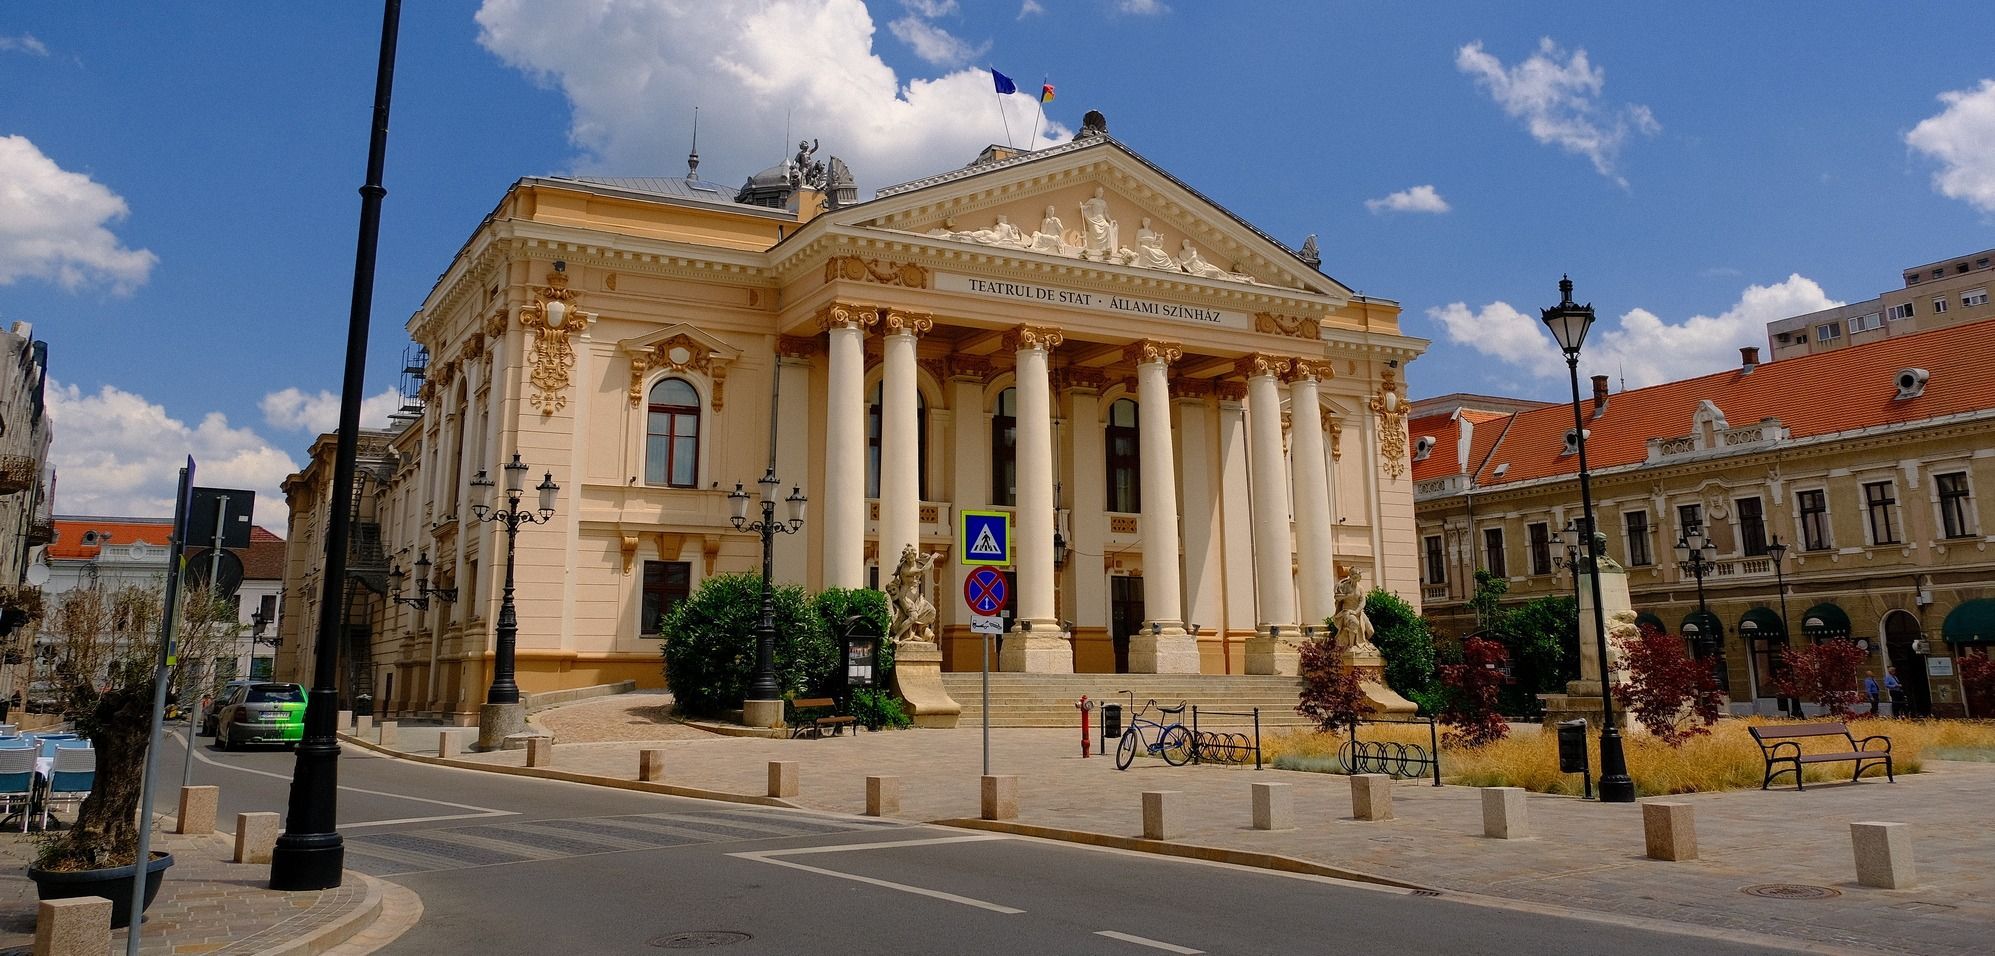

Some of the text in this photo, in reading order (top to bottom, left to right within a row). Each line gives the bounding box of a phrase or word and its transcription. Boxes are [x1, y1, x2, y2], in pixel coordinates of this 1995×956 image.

[969, 279, 1221, 323] TEATRUL DE STAT ÁLLAMI SZÍNHÁZ
